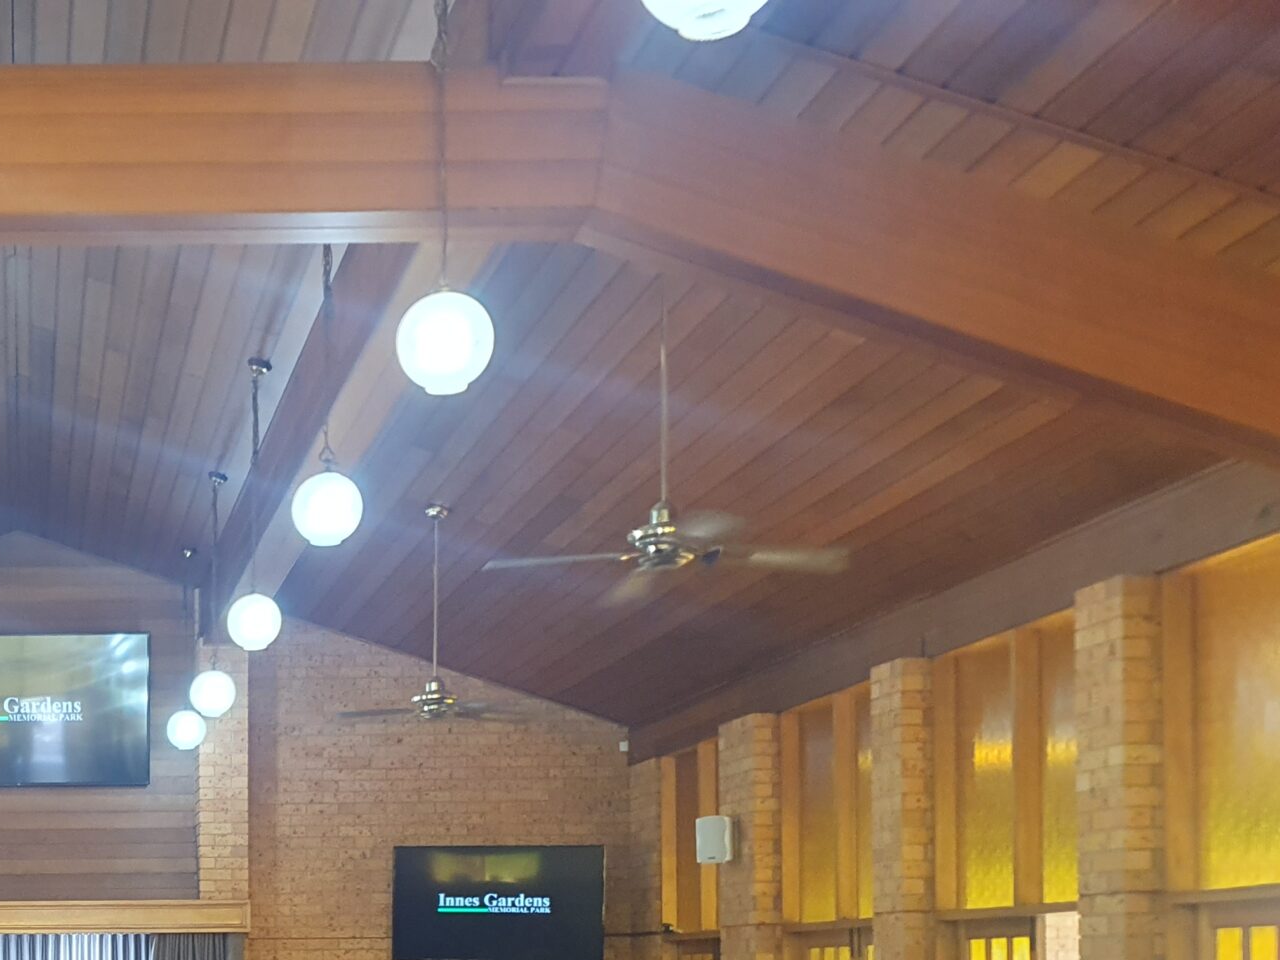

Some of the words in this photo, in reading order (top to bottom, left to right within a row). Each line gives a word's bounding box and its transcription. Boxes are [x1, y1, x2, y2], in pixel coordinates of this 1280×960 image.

[3, 697, 82, 714] Gardens
[59, 713, 83, 722] PARK
[438, 893, 480, 907] Innes
[483, 893, 551, 907] Gardens
